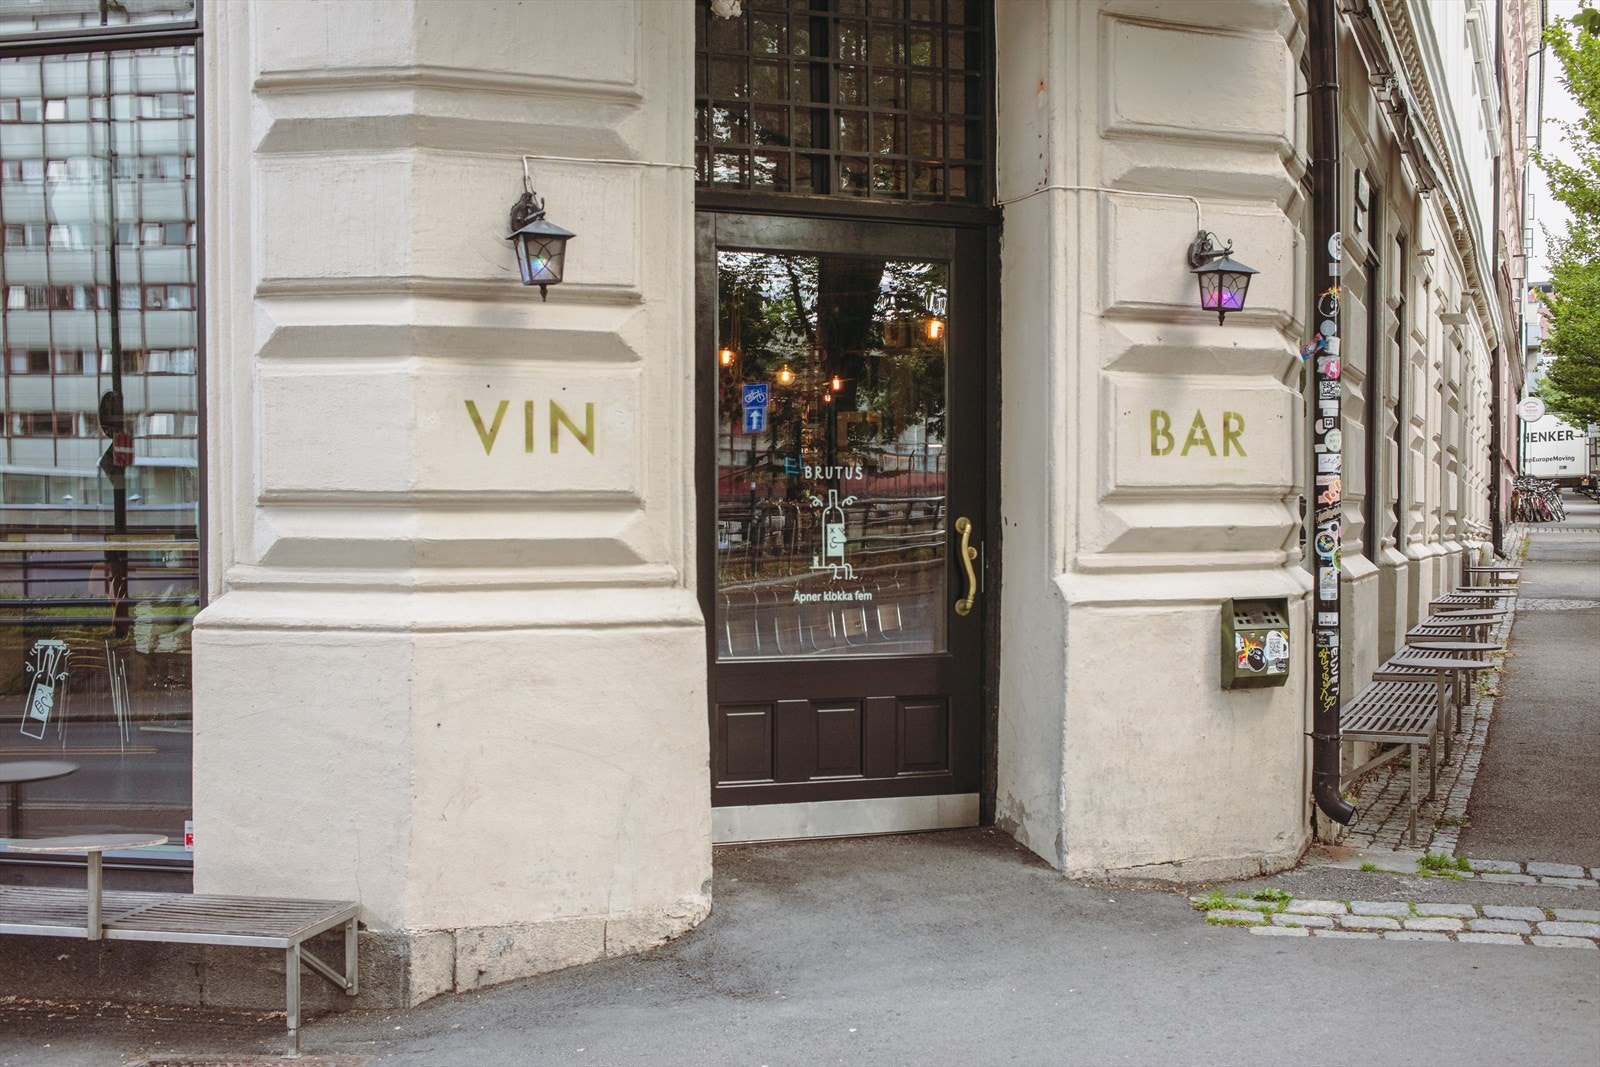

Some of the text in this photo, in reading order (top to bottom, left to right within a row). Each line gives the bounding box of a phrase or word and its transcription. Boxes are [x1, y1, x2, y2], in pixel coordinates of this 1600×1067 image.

[465, 399, 595, 456] VIN
[1150, 409, 1248, 458] BAR
[804, 465, 864, 480] BRUTUS
[793, 590, 873, 604] Åpner klokka fem
